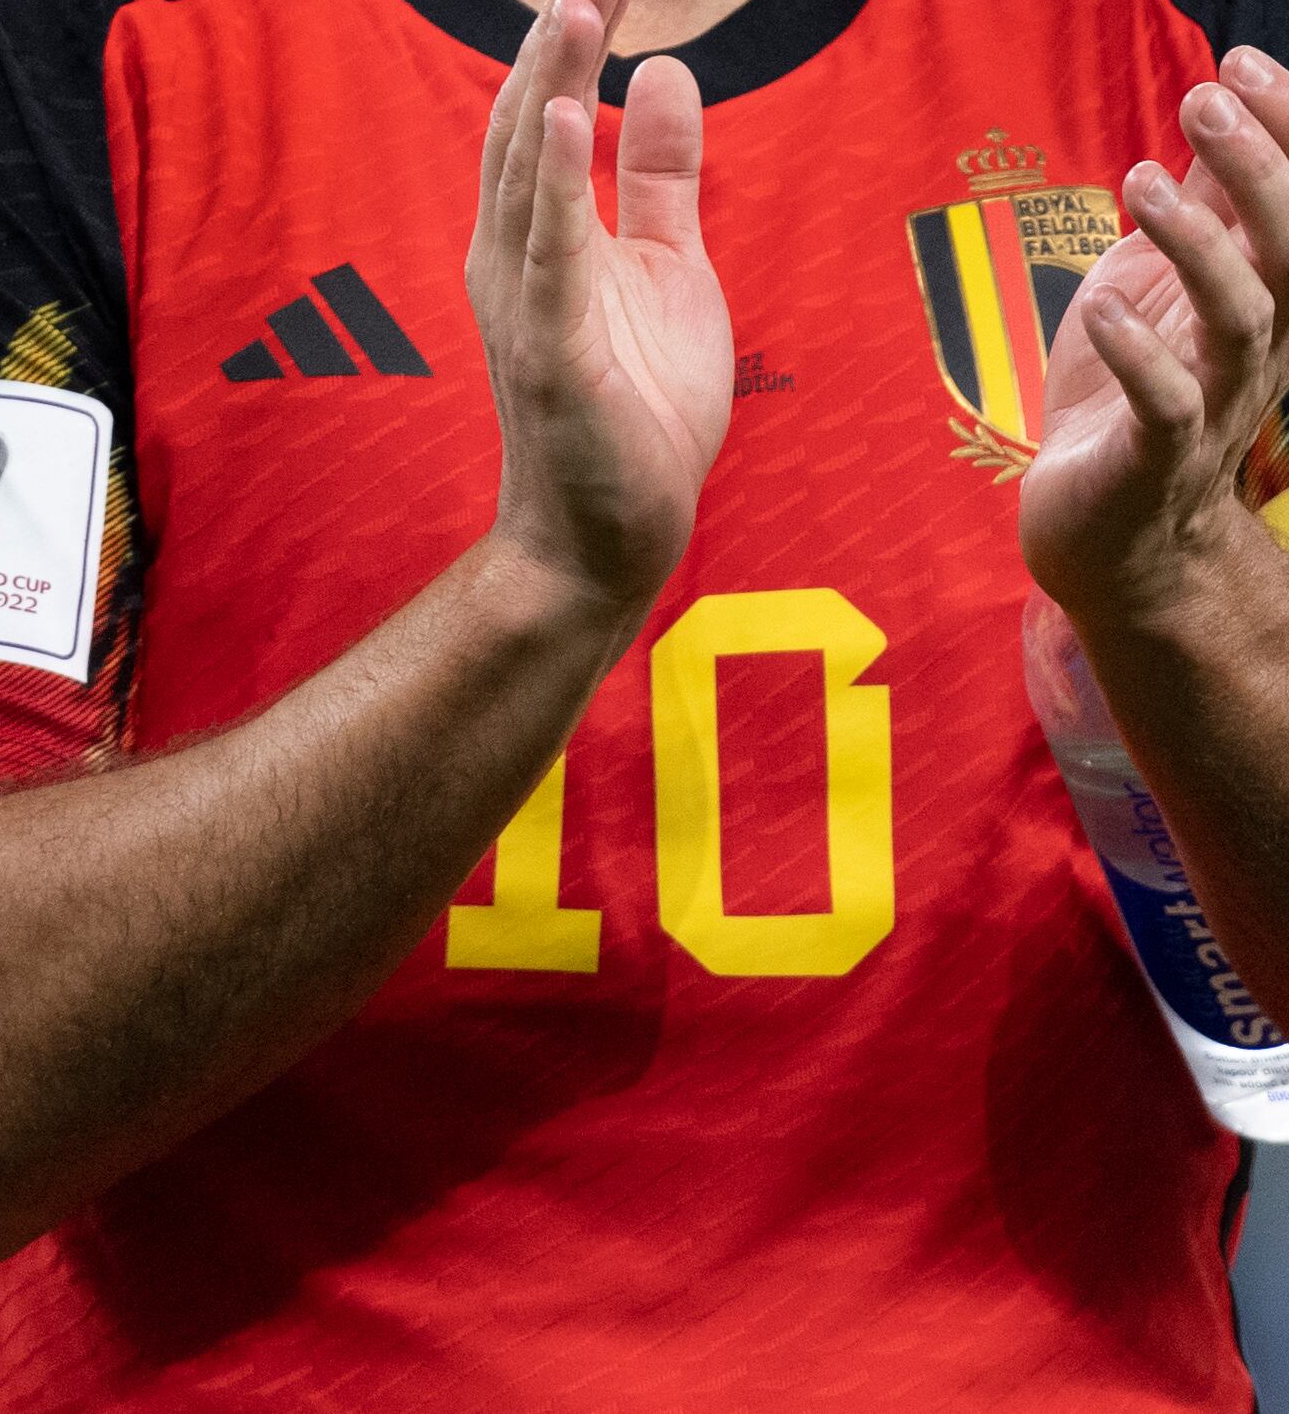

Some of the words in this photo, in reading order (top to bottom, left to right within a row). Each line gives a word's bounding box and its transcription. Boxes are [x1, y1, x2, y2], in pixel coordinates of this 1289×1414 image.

[1018, 193, 1091, 217] ROYAL
[1021, 216, 1116, 238] BELGIAN
[12, 575, 52, 594] CUP
[444, 586, 896, 978] 10
